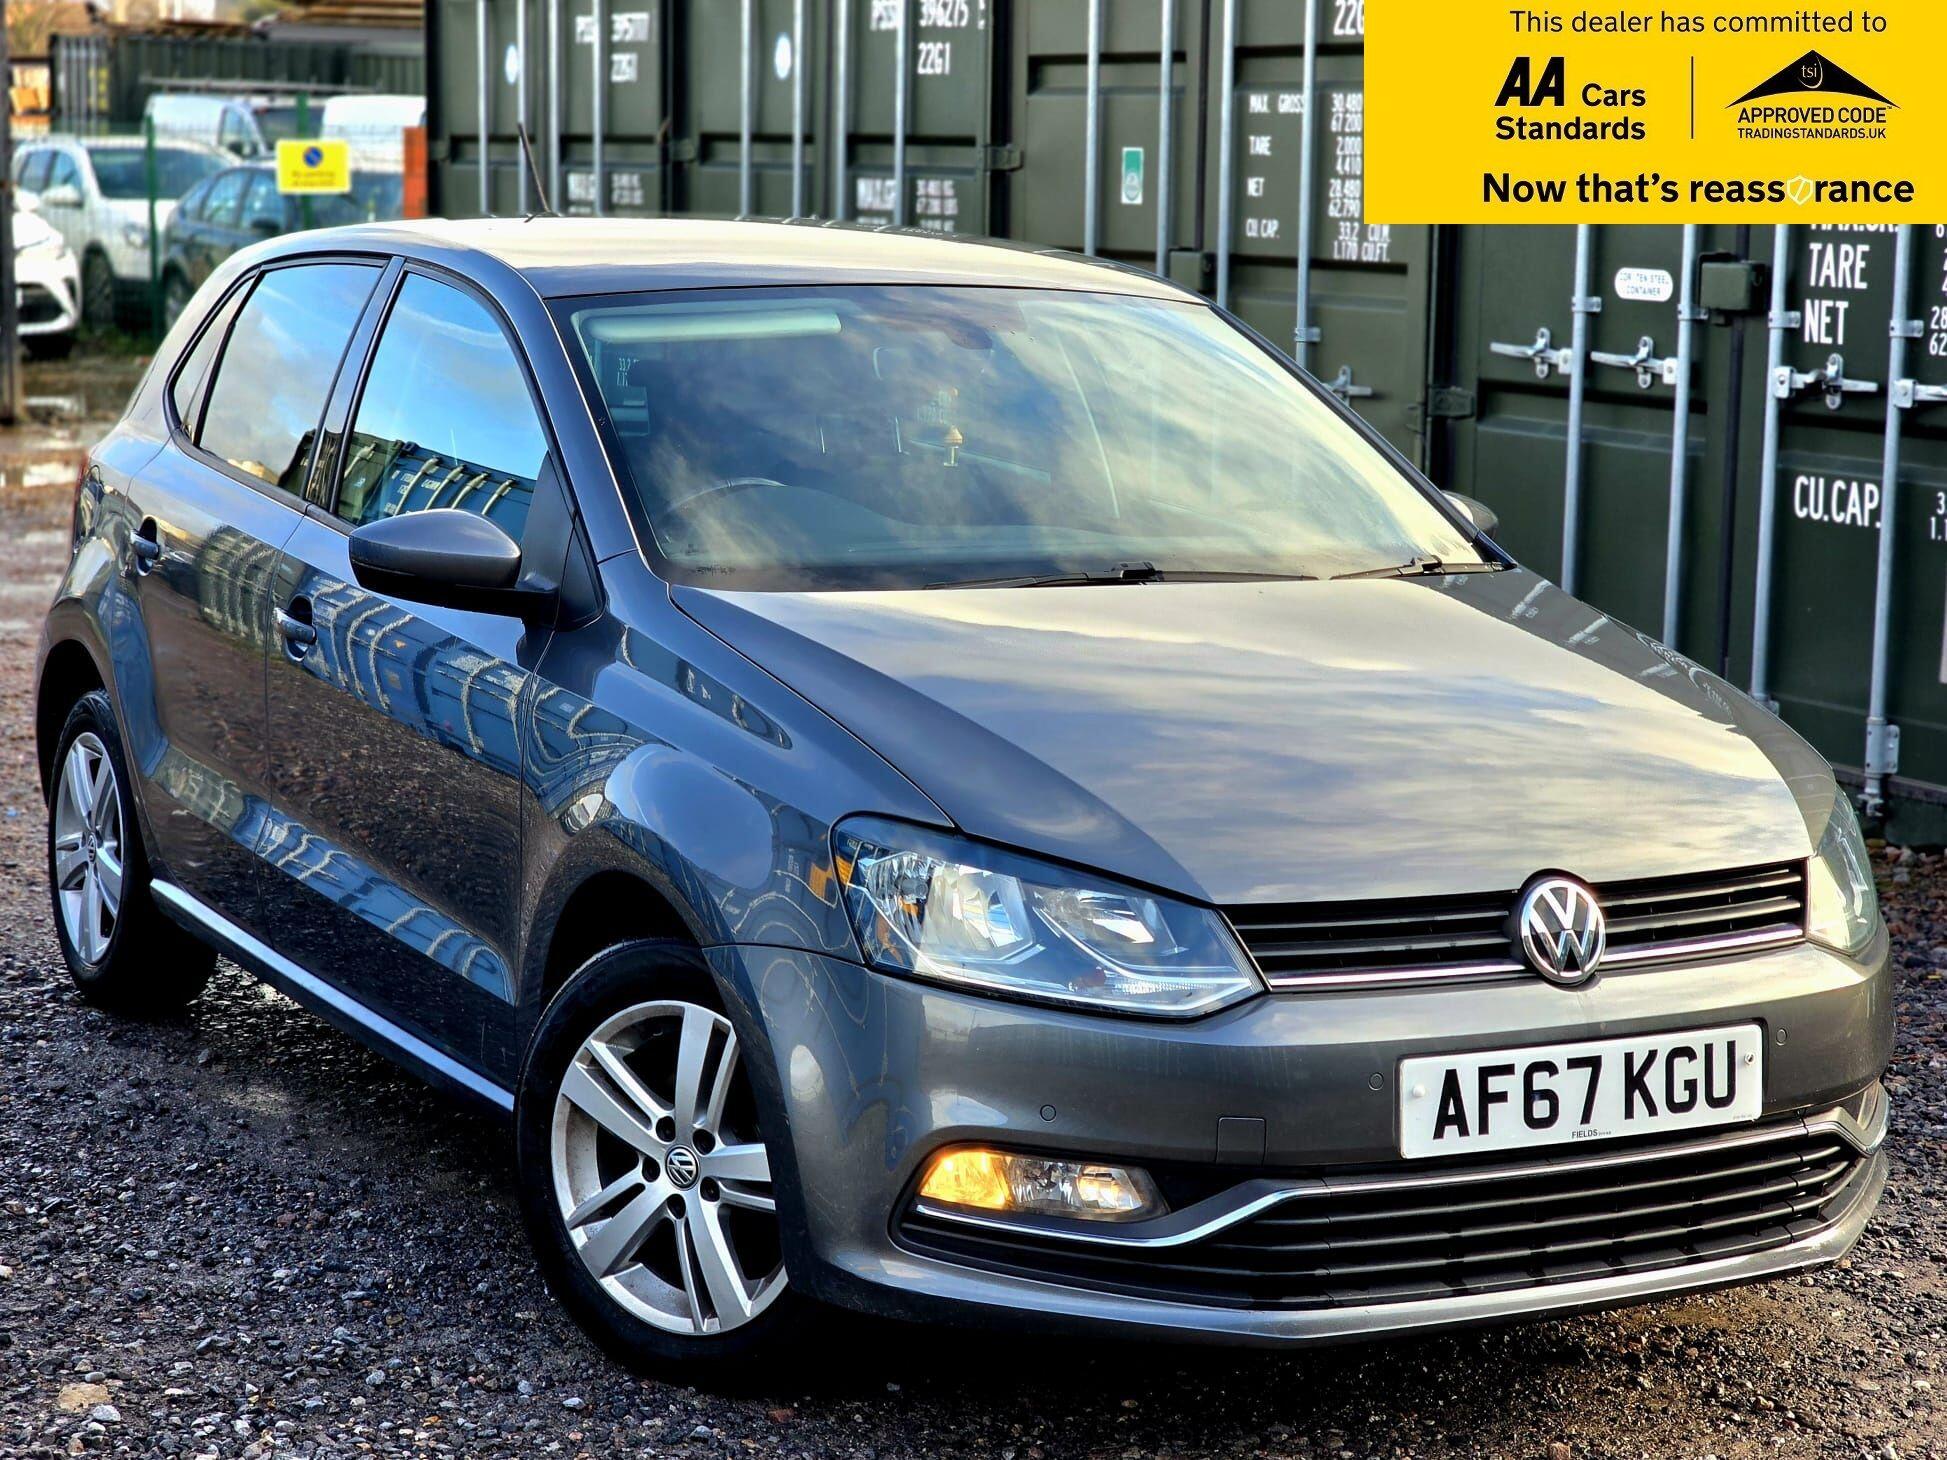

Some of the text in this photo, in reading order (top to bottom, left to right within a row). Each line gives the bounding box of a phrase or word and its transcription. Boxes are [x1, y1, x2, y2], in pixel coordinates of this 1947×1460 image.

[917, 41, 951, 75] 22G1
[1249, 136, 1271, 155] TARE
[1247, 177, 1265, 196] NET
[1809, 242, 1870, 289] TARE
[1804, 299, 1849, 345] NET
[1433, 1040, 1736, 1140] AF67 KGU
[1572, 1129, 1598, 1139] FIELDS
